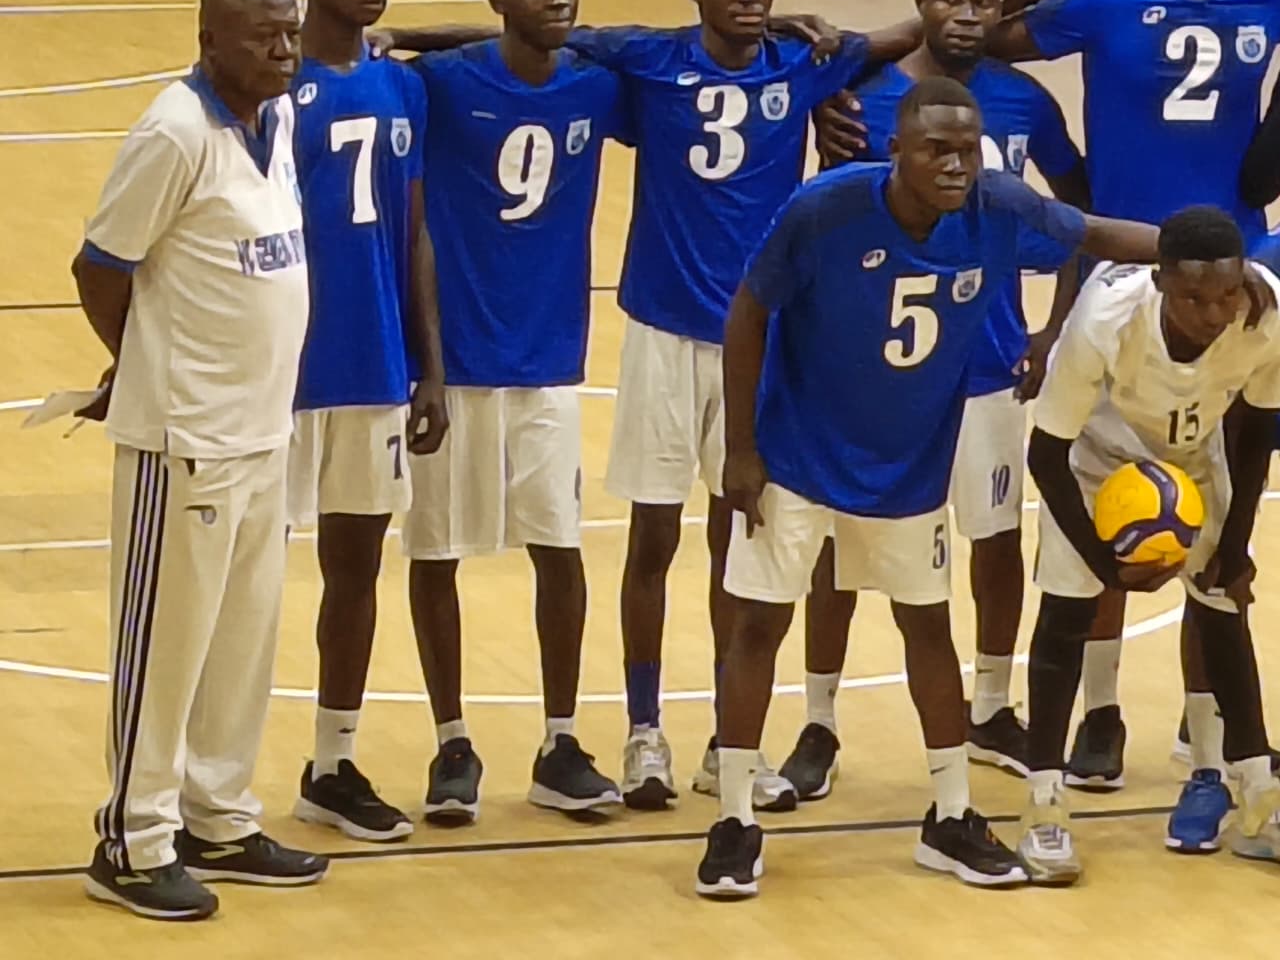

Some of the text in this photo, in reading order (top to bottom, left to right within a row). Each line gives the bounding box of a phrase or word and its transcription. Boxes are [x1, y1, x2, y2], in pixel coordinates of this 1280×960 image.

[1163, 25, 1221, 121] 2
[331, 116, 377, 224] 7
[499, 125, 554, 220] 9
[689, 85, 748, 179] 3
[884, 274, 939, 367] 5
[387, 435, 403, 480] 7
[1168, 404, 1200, 445] 15
[991, 465, 1010, 508] 10
